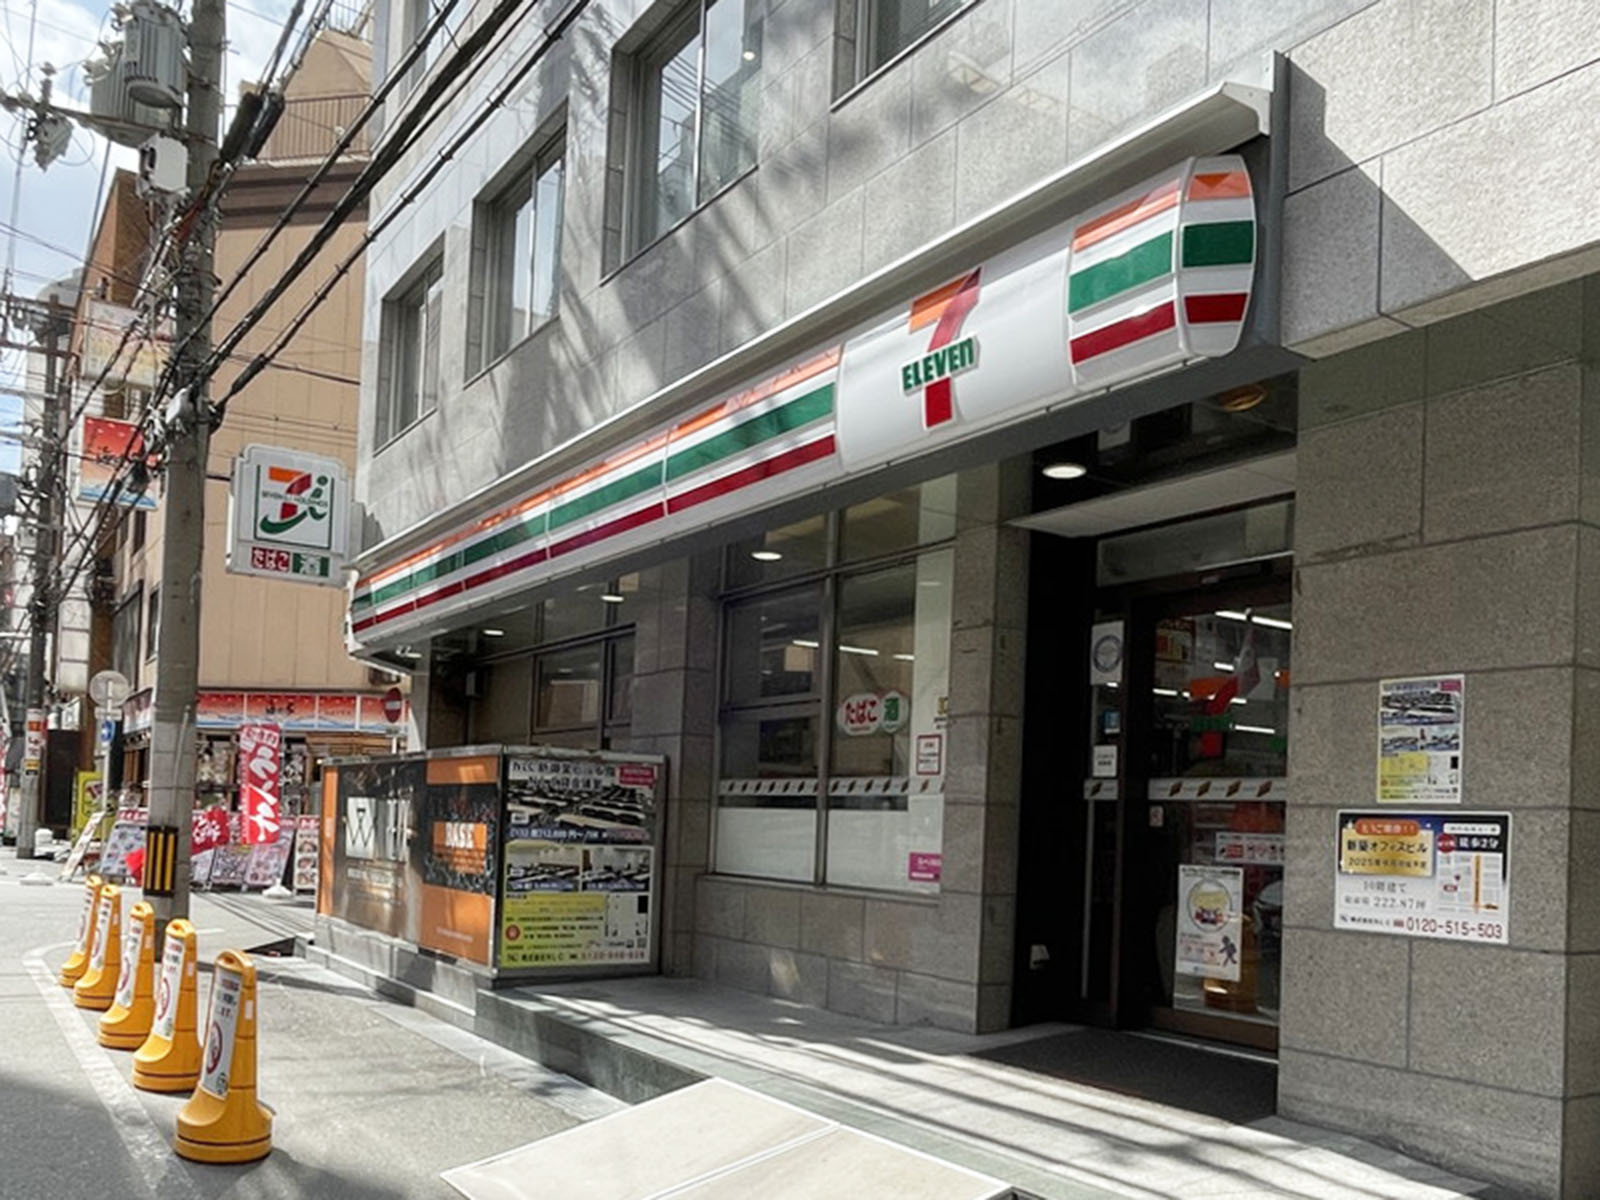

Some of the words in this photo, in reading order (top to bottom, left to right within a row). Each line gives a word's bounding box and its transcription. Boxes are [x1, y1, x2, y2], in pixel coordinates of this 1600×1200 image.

[909, 267, 981, 428] 7
[844, 698, 878, 725] たばこ
[1347, 839, 1429, 854] 新築オフィスビル
[1406, 916, 1503, 939] 0120-515-503
